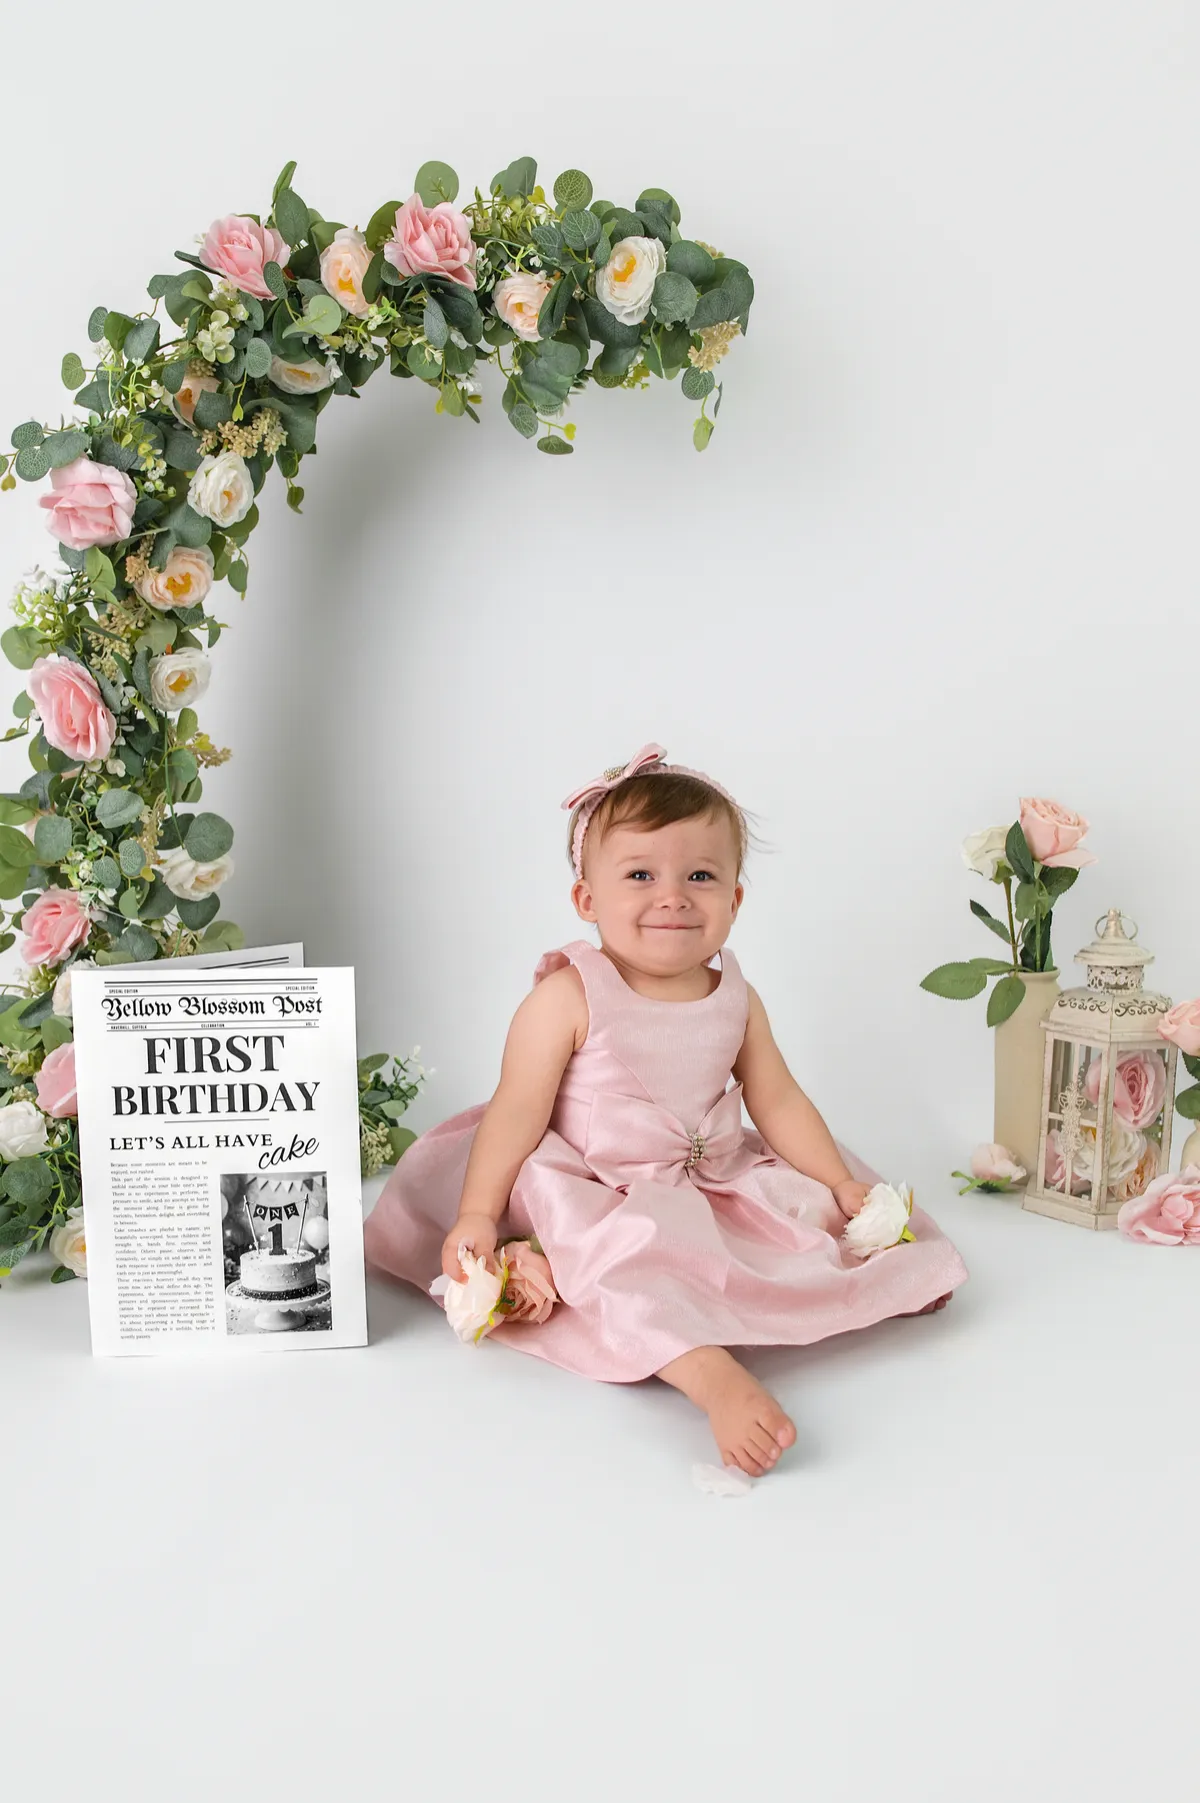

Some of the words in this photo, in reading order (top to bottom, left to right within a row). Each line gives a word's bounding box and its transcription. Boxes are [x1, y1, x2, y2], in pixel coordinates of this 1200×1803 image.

[101, 998, 172, 1021] Yellow
[178, 996, 266, 1016] Blossom
[272, 995, 323, 1018] Post
[142, 1035, 285, 1074] FIRST
[111, 1082, 320, 1116] BIRTHDAY
[110, 1136, 164, 1151] LET'S
[172, 1136, 210, 1149] ALL
[215, 1134, 273, 1148] HAVE
[258, 1134, 320, 1170] cake
[257, 1206, 296, 1218] ONE
[268, 1223, 288, 1256] 1
